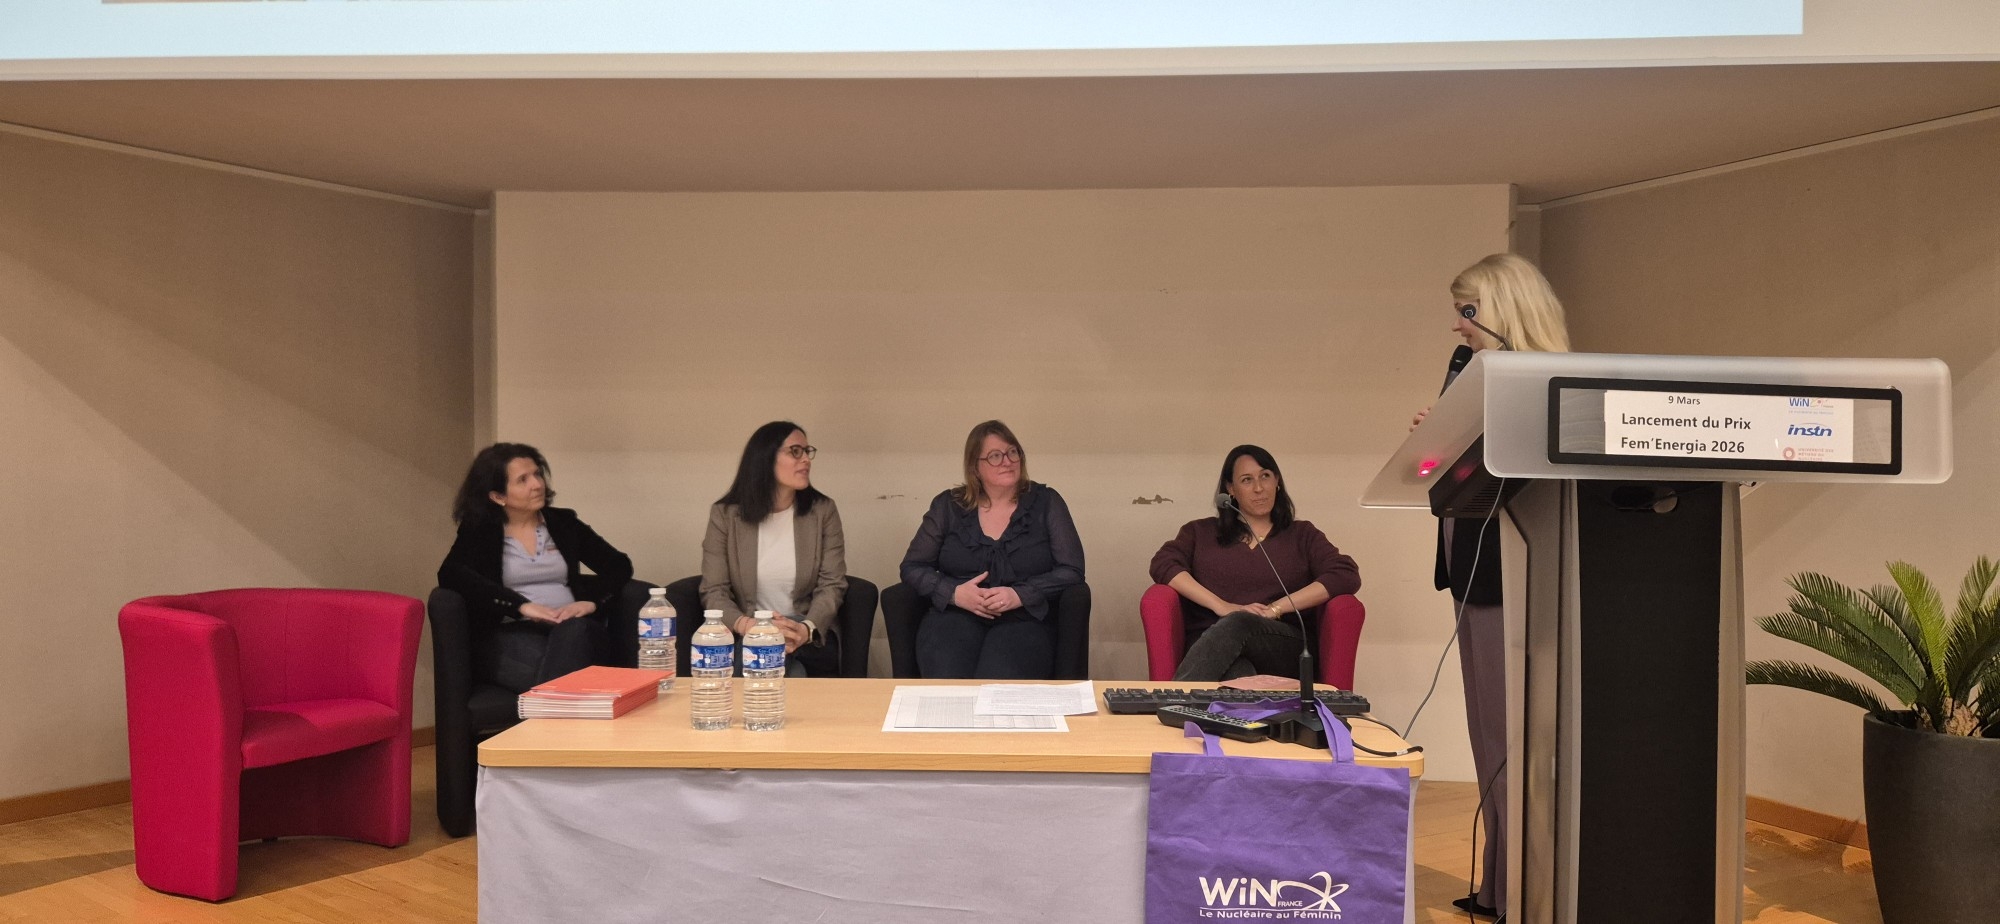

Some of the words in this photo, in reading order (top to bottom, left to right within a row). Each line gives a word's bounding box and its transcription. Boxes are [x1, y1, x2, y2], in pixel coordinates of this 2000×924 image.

[1668, 395, 1674, 403] 9
[1677, 396, 1701, 405] Mars
[1789, 397, 1810, 407] WiN
[1622, 413, 1698, 428] Lancement
[1702, 416, 1720, 429] du
[1724, 417, 1751, 430] Prix
[1787, 424, 1832, 437] instn
[1621, 436, 1707, 454] Fem'Energia
[1711, 440, 1745, 453] 2026
[1199, 876, 1278, 907] WiN
[1200, 909, 1214, 918] Le
[1217, 910, 1273, 919] Nucléaire
[1293, 911, 1342, 920] Féminin
